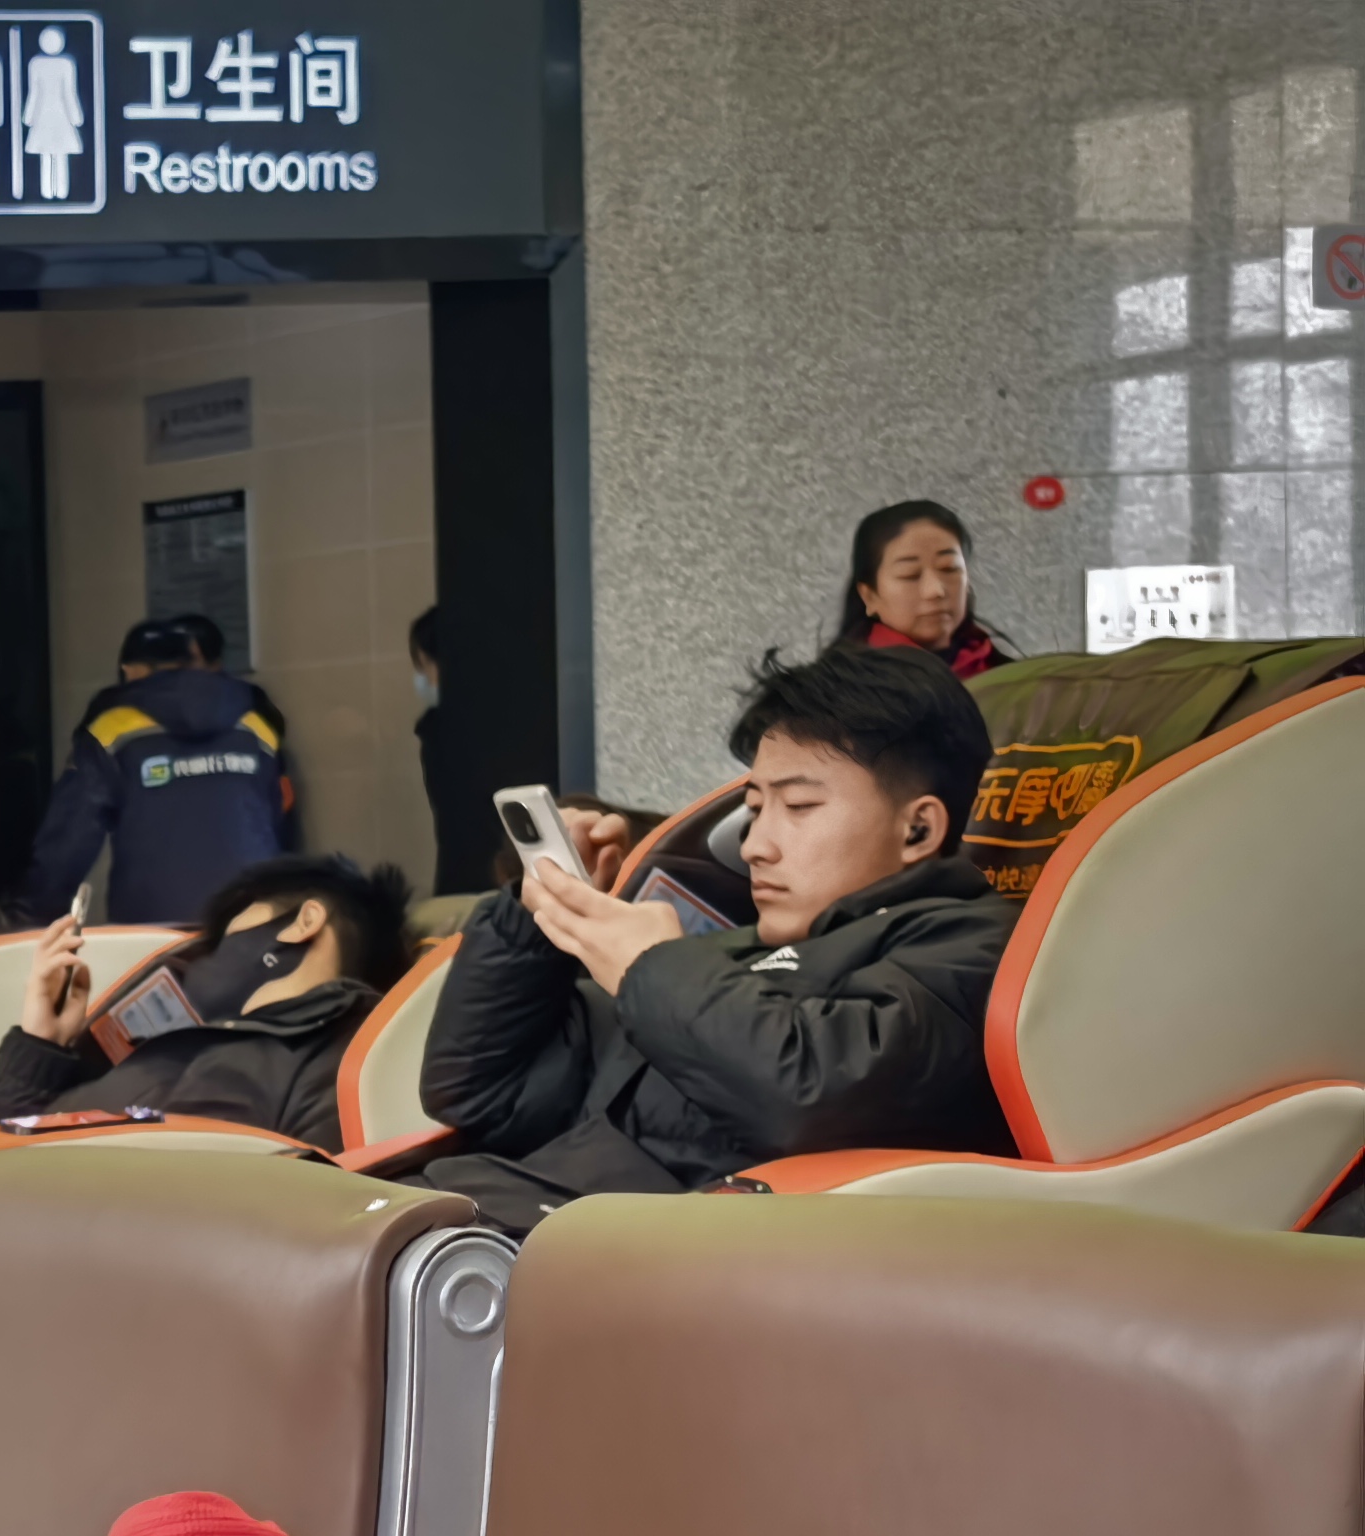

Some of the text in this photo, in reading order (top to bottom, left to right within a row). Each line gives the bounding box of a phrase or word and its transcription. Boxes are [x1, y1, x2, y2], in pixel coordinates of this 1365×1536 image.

[123, 29, 361, 125] 卫生间
[123, 141, 379, 194] Restrooms
